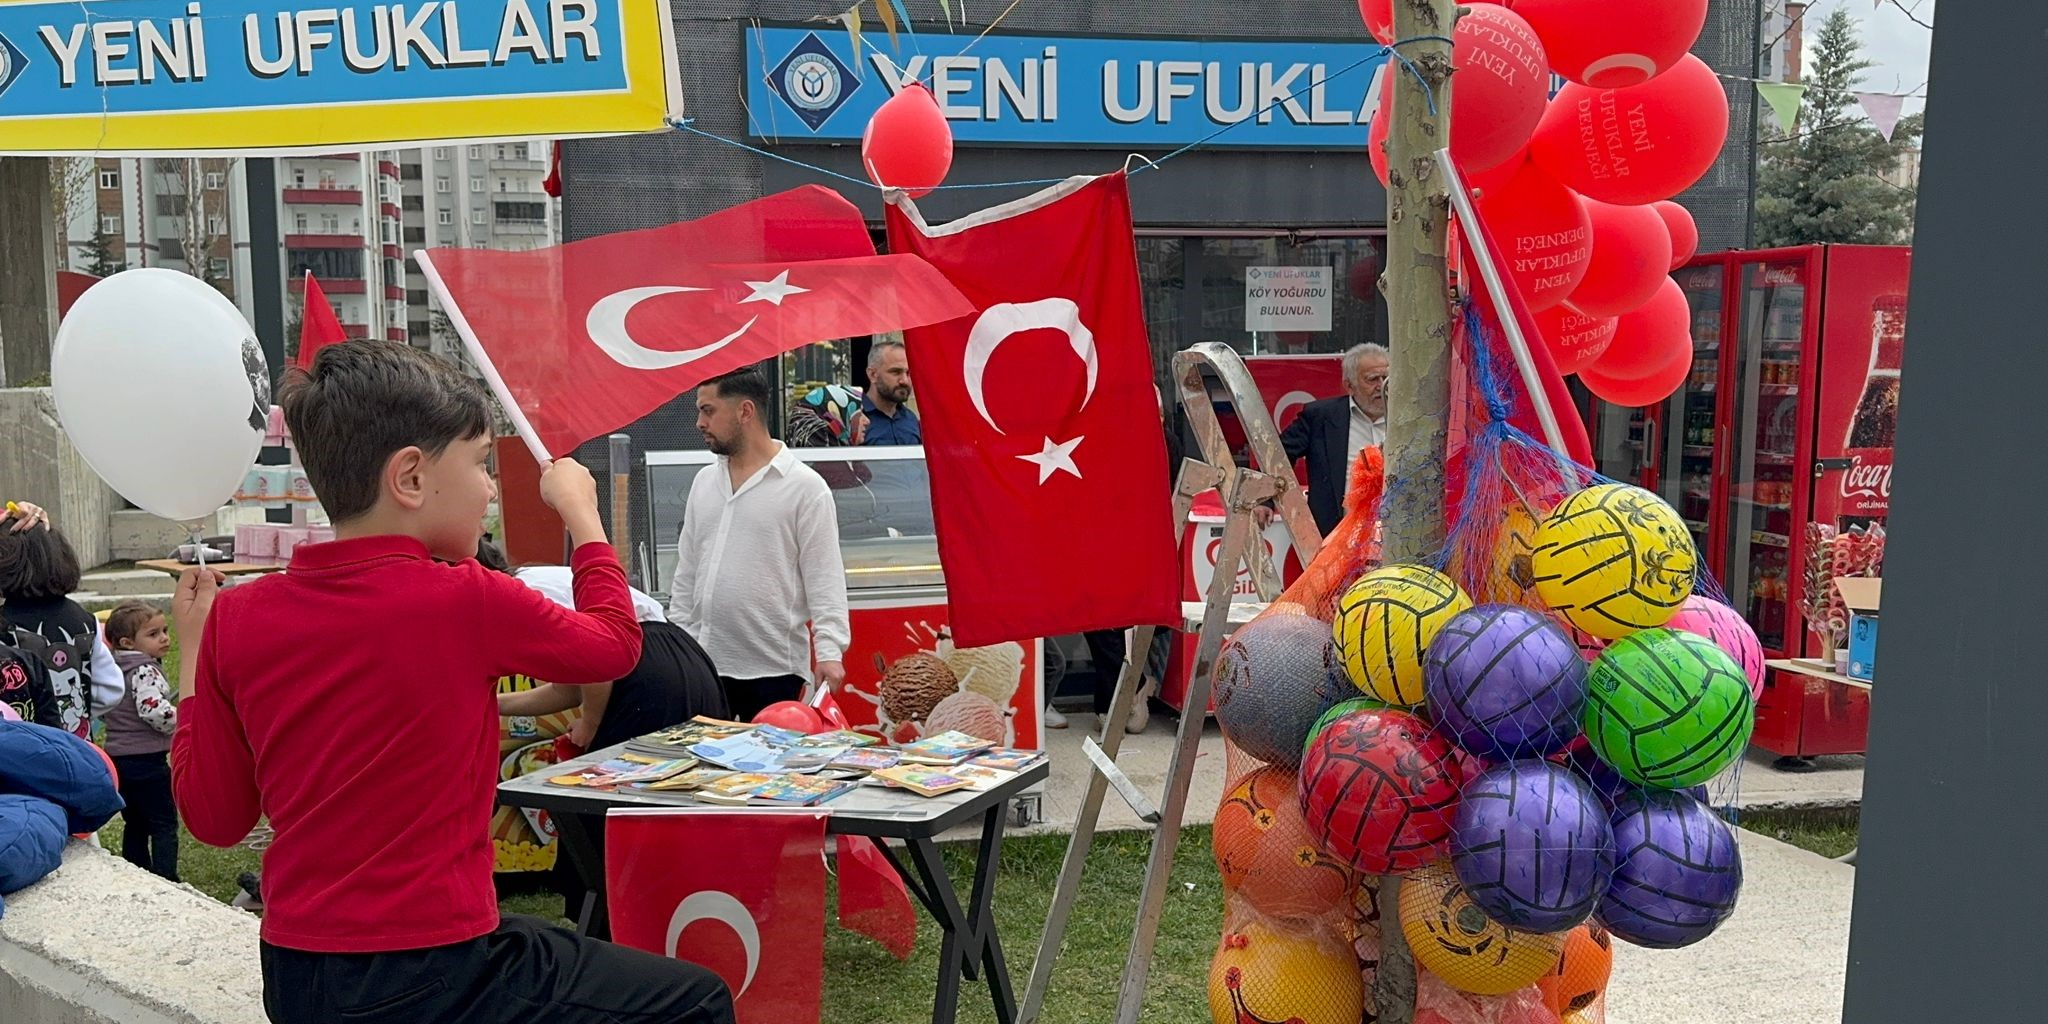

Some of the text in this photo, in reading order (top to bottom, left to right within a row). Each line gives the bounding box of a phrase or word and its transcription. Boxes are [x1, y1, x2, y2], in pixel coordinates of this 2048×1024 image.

[38, 0, 601, 85] YENİ UFUKLAR
[1457, 20, 1541, 81] UFUKLAR
[1473, 9, 1545, 62] DERNEĞ
[871, 46, 1057, 120] YENİ
[1466, 47, 1516, 86] YENİ
[1578, 97, 1610, 179] DERNEĞİ
[1600, 88, 1630, 178] UFUKLAR
[1627, 103, 1655, 152] YENİ
[1514, 247, 1587, 272] UFUKLAR
[1516, 226, 1585, 253] DERNEĞİ
[1249, 286, 1327, 298] KÖY YOĞURDU
[1284, 270, 1321, 279] UFUKLAR
[1534, 271, 1572, 293] YENİ
[1260, 306, 1314, 316] BULUNUR.
